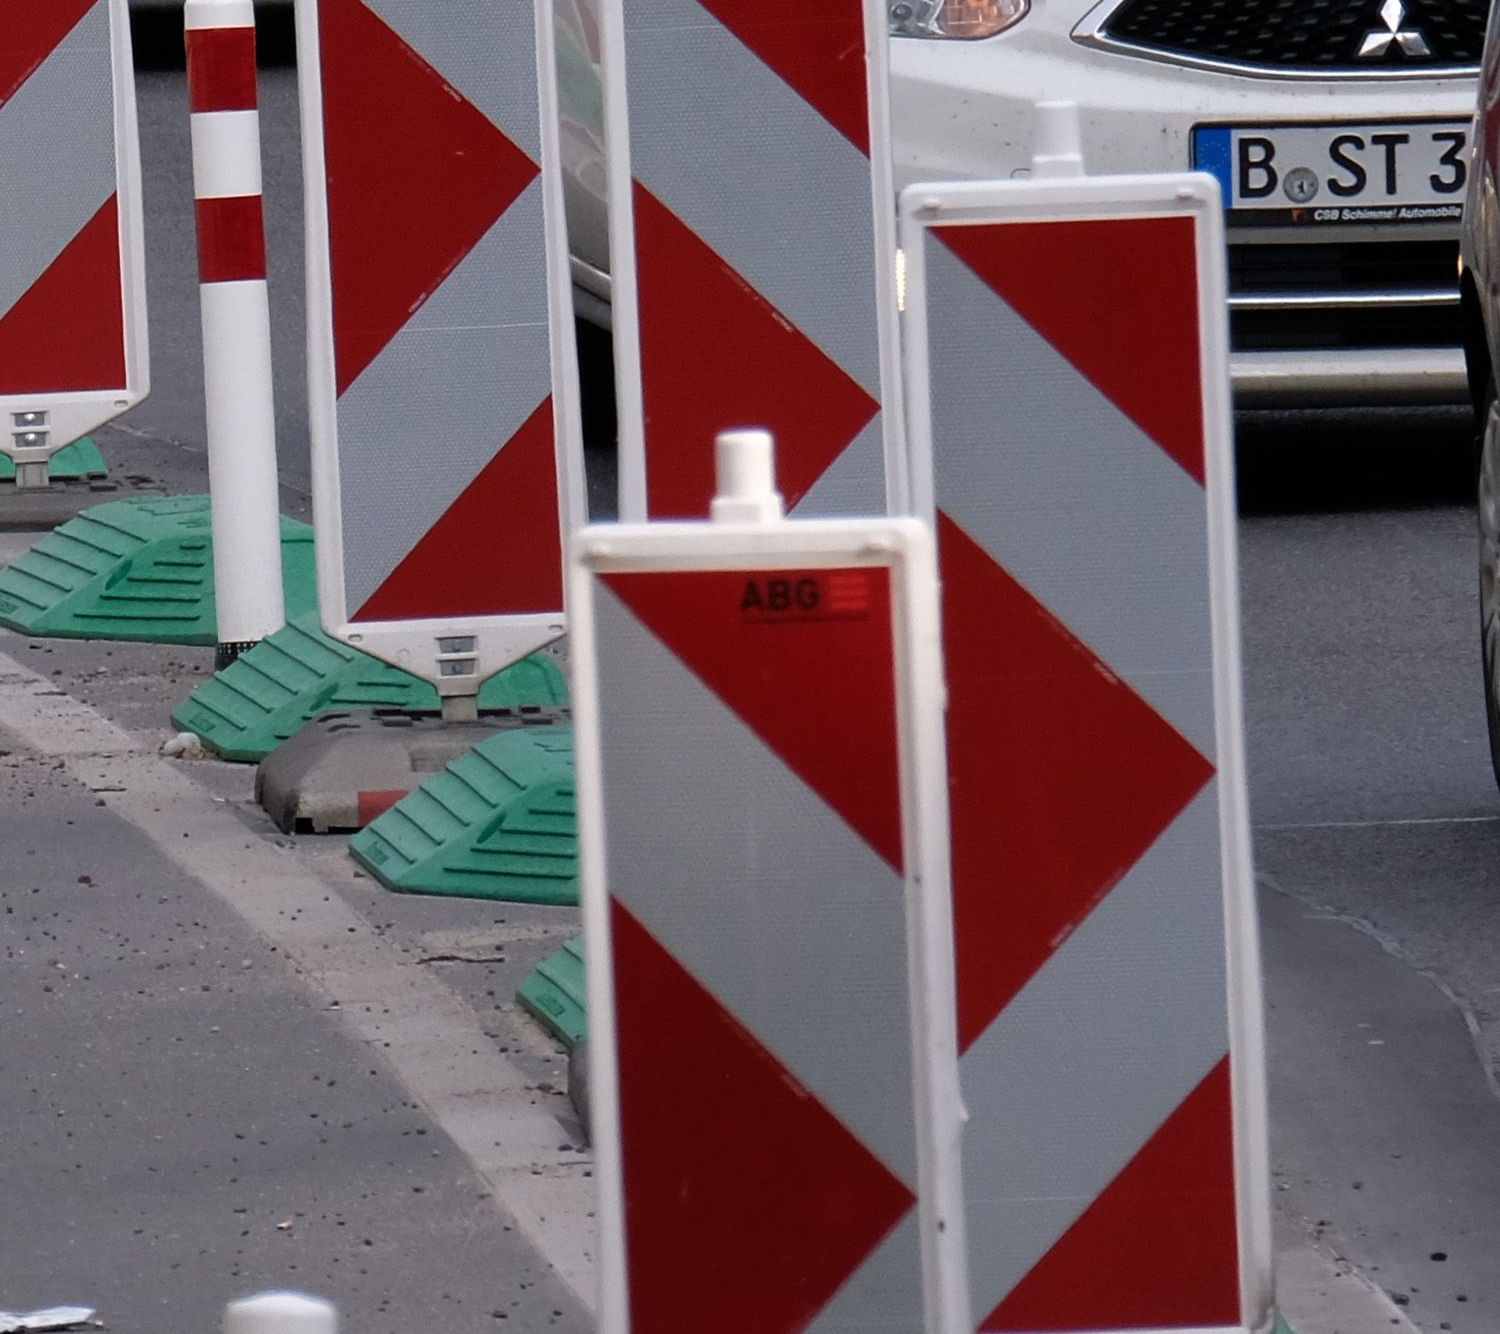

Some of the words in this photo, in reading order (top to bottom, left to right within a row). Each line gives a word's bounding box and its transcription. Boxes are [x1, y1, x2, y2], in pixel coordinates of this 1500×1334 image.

[1237, 137, 1279, 199] B
[1326, 133, 1410, 197] ST
[1429, 131, 1467, 194] 3
[740, 578, 821, 613] ABG
